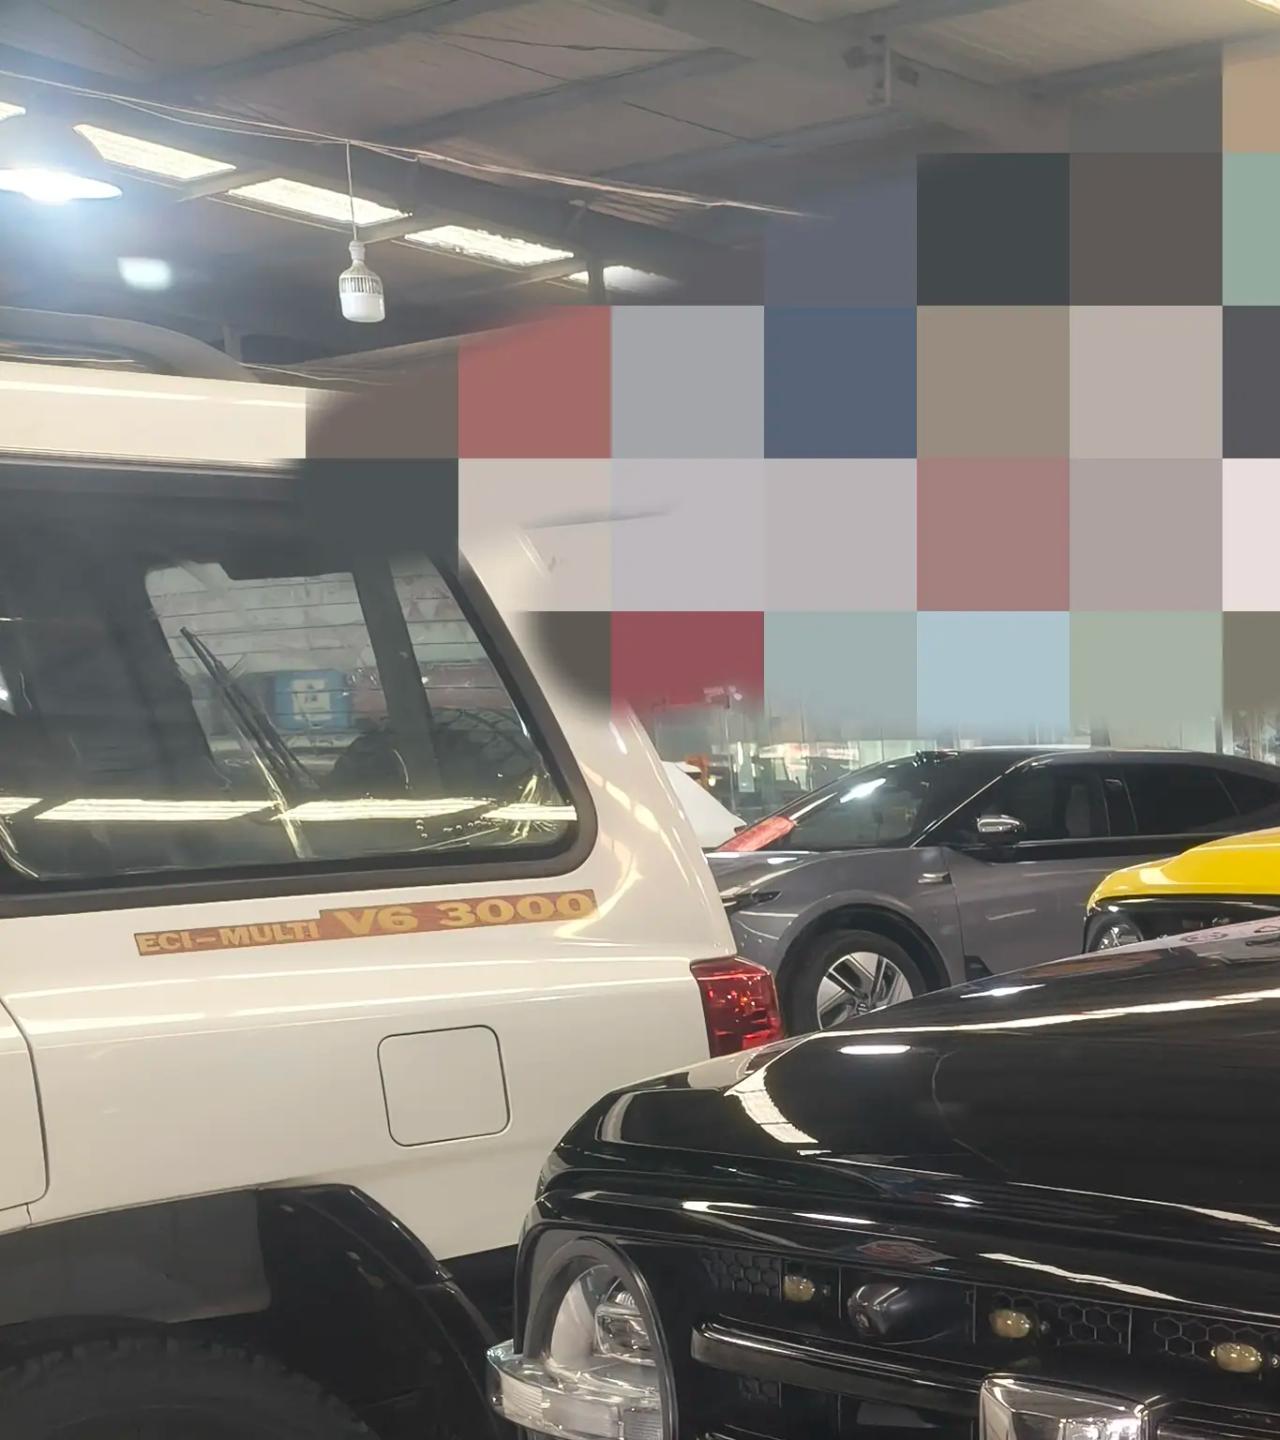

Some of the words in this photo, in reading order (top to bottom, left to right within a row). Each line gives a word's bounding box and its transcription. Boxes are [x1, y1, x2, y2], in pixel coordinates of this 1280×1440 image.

[138, 918, 320, 954] ECI-MULTI
[333, 906, 418, 936] V6
[437, 892, 596, 926] 3000
